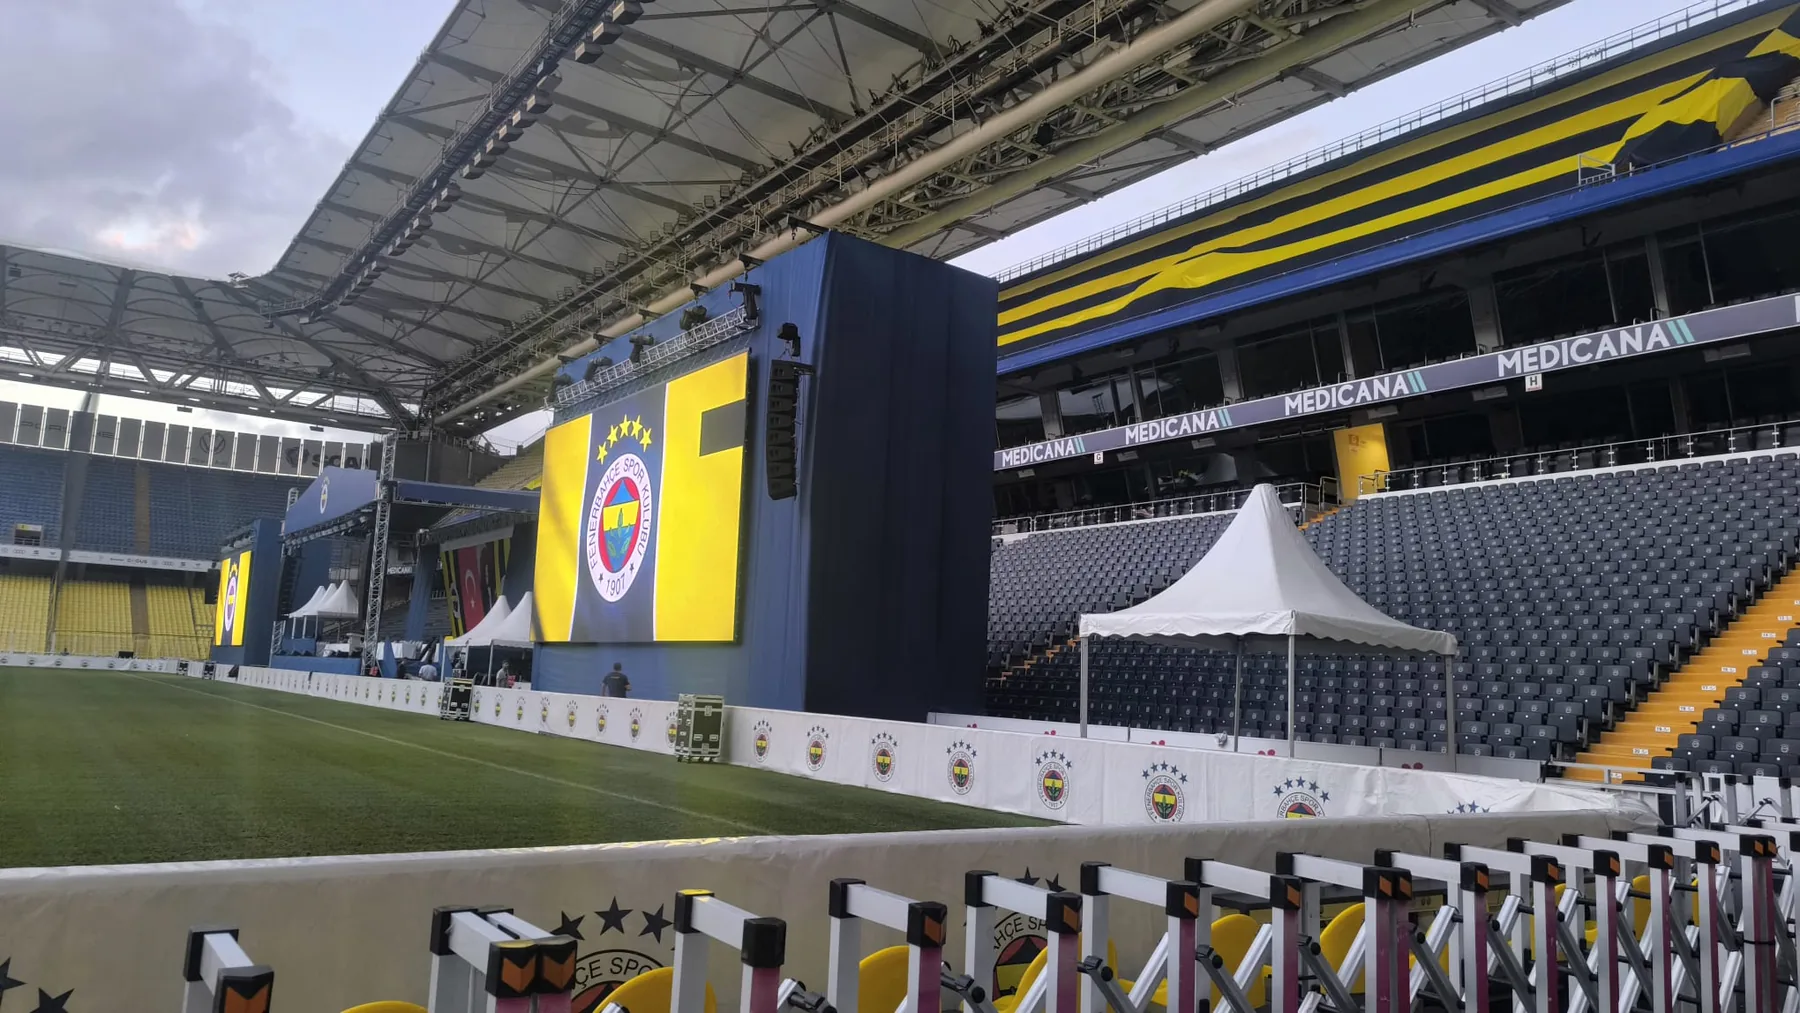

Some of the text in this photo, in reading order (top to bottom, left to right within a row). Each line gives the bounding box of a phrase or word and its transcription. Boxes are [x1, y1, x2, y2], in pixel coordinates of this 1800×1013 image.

[1497, 323, 1671, 377] MEDICANA
[1285, 374, 1410, 416] MEDICANA
[1530, 376, 1537, 386] H
[1125, 410, 1220, 446] MEDICANA
[1001, 438, 1077, 468] MEDICANA
[1096, 453, 1102, 462] G
[623, 457, 645, 484] SPOR
[605, 573, 626, 597] 1907
